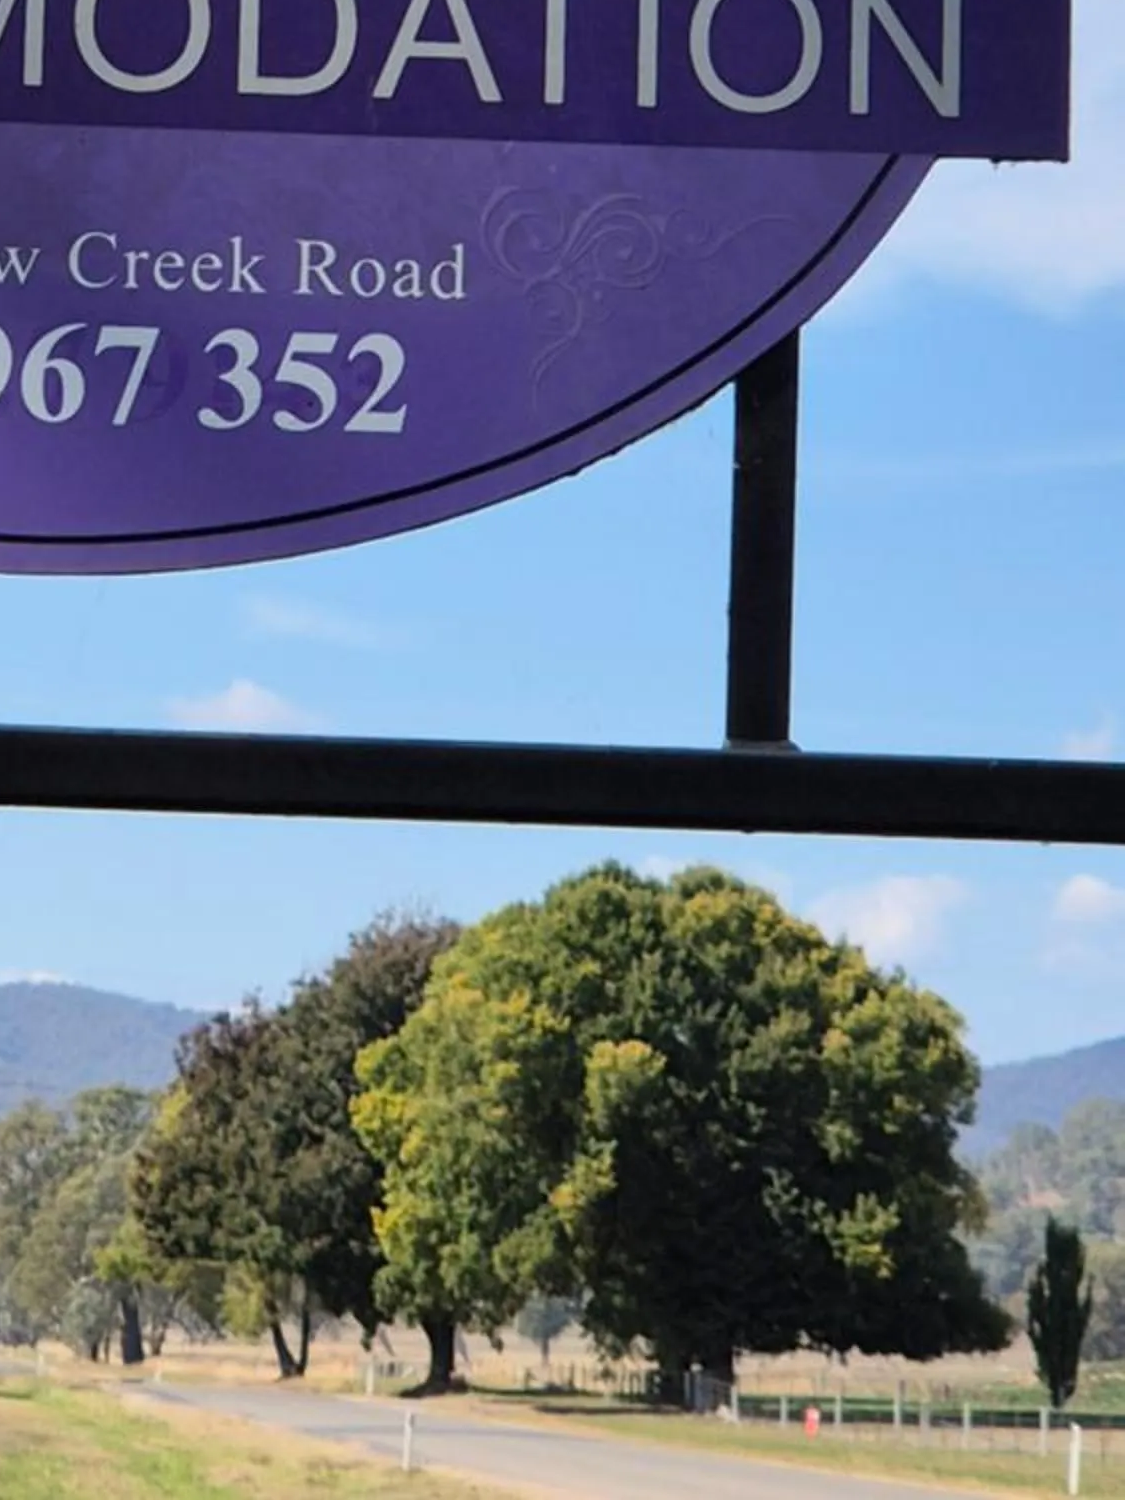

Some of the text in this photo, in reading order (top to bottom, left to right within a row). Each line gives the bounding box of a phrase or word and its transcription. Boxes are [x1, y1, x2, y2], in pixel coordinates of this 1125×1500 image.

[67, 231, 266, 295] Creek
[293, 237, 468, 301] Road
[197, 327, 409, 435] 352
